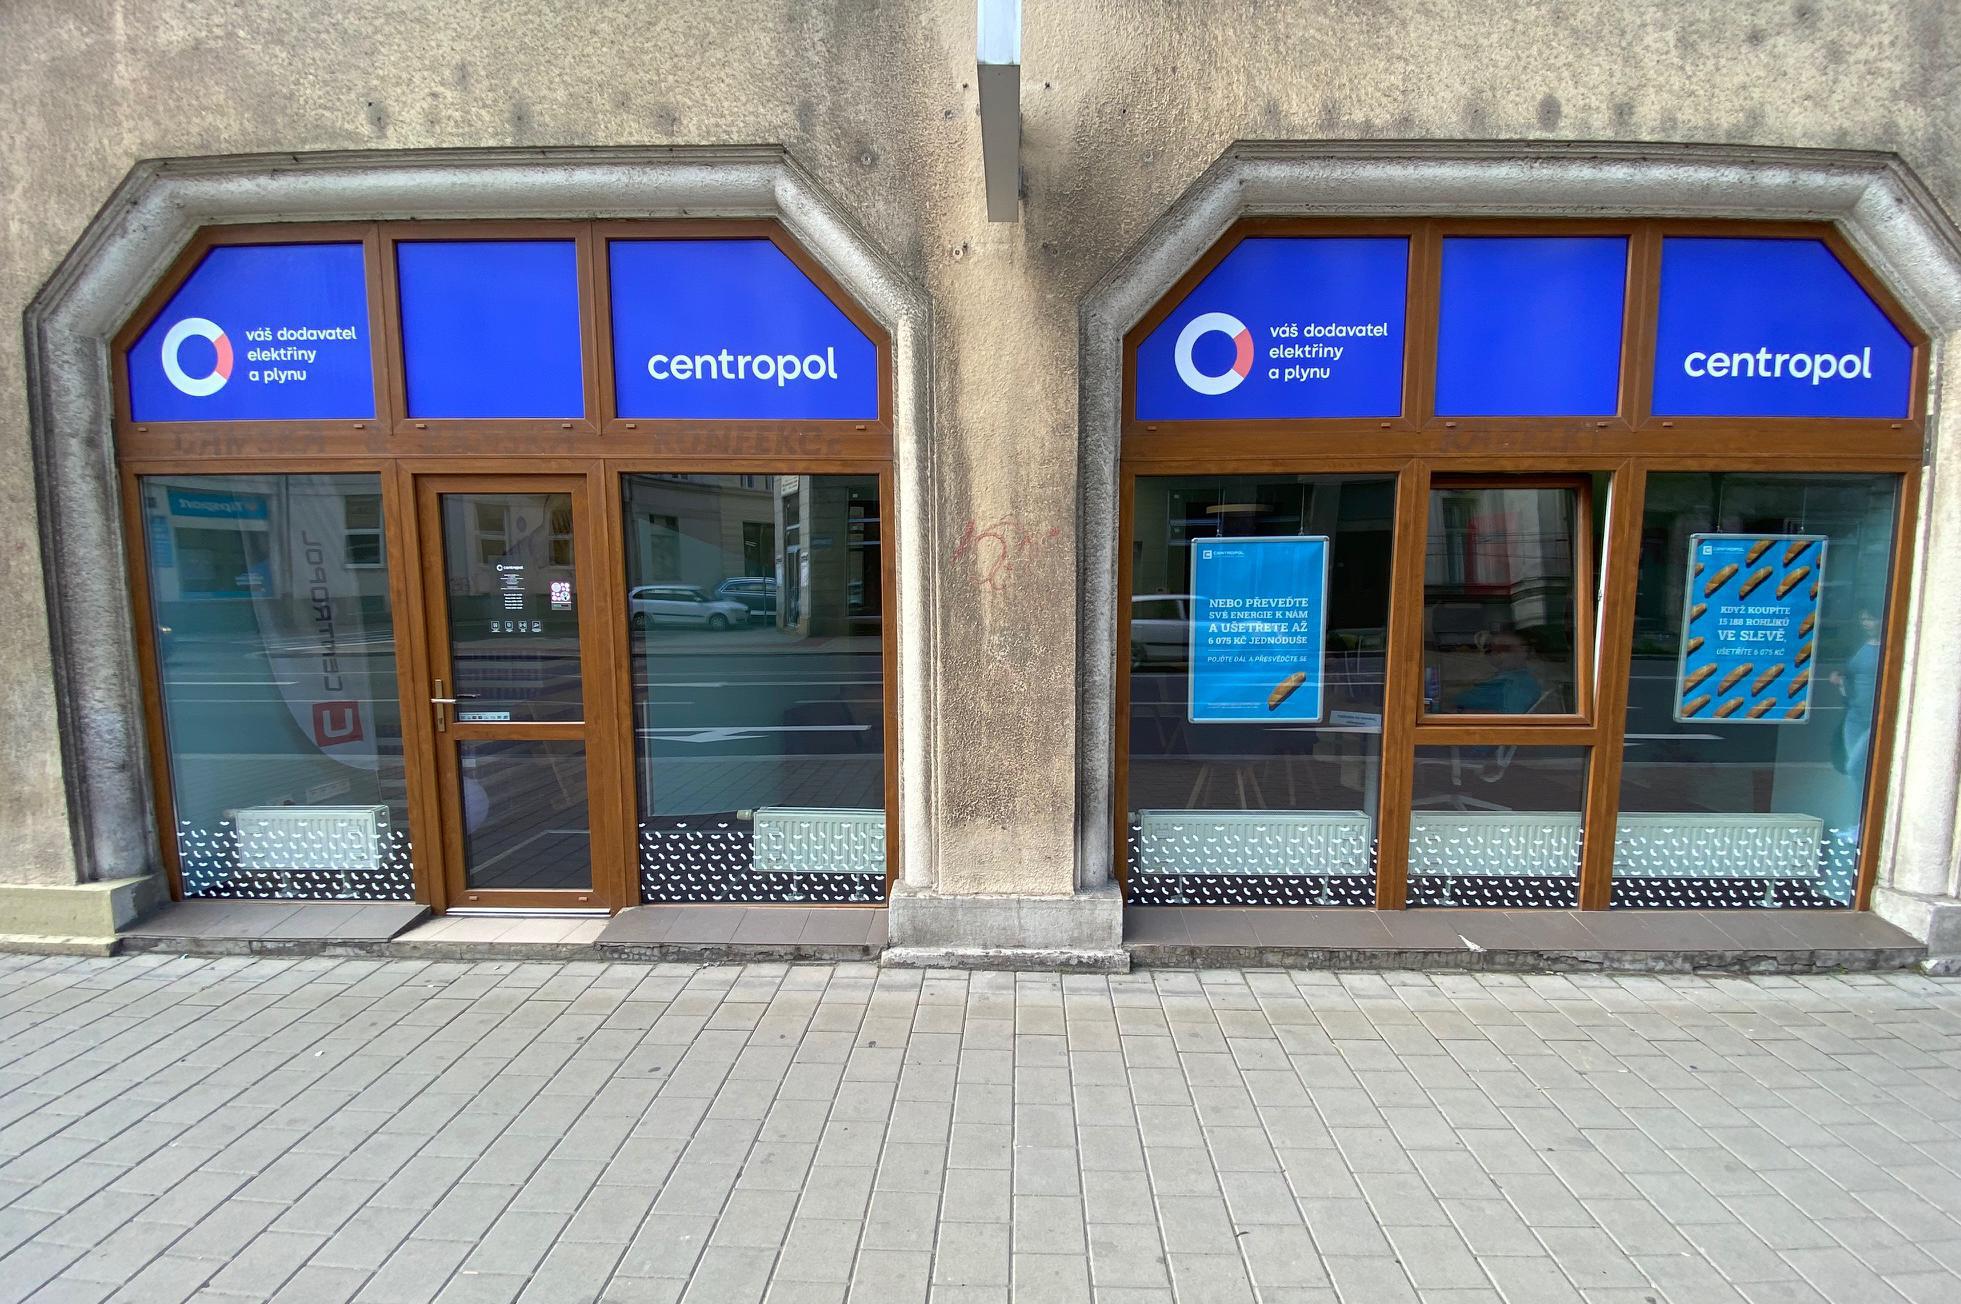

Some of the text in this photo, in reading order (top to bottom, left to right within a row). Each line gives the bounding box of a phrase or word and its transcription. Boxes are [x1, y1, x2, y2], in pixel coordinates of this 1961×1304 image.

[246, 326, 358, 342] váš dodavatel
[1269, 322, 1388, 338] váš dodavatel
[247, 346, 317, 363] elektřiny
[1269, 344, 1344, 361] elektřiny
[647, 346, 838, 387] centropol
[1268, 365, 1331, 382] a plynu
[1684, 347, 1872, 386] centropol
[248, 367, 307, 385] a plynu
[1209, 598, 1243, 608] NEBO
[1720, 605, 1791, 615] KDYŽ KOUPÍTE
[1208, 610, 1309, 619] SVÉ ENERGIE K NÁM
[1208, 623, 1218, 633] A
[1291, 620, 1308, 632] AŽ
[1208, 635, 1308, 645] 6 075 KČ JEDNODUŠE
[1717, 629, 1736, 641] VE
